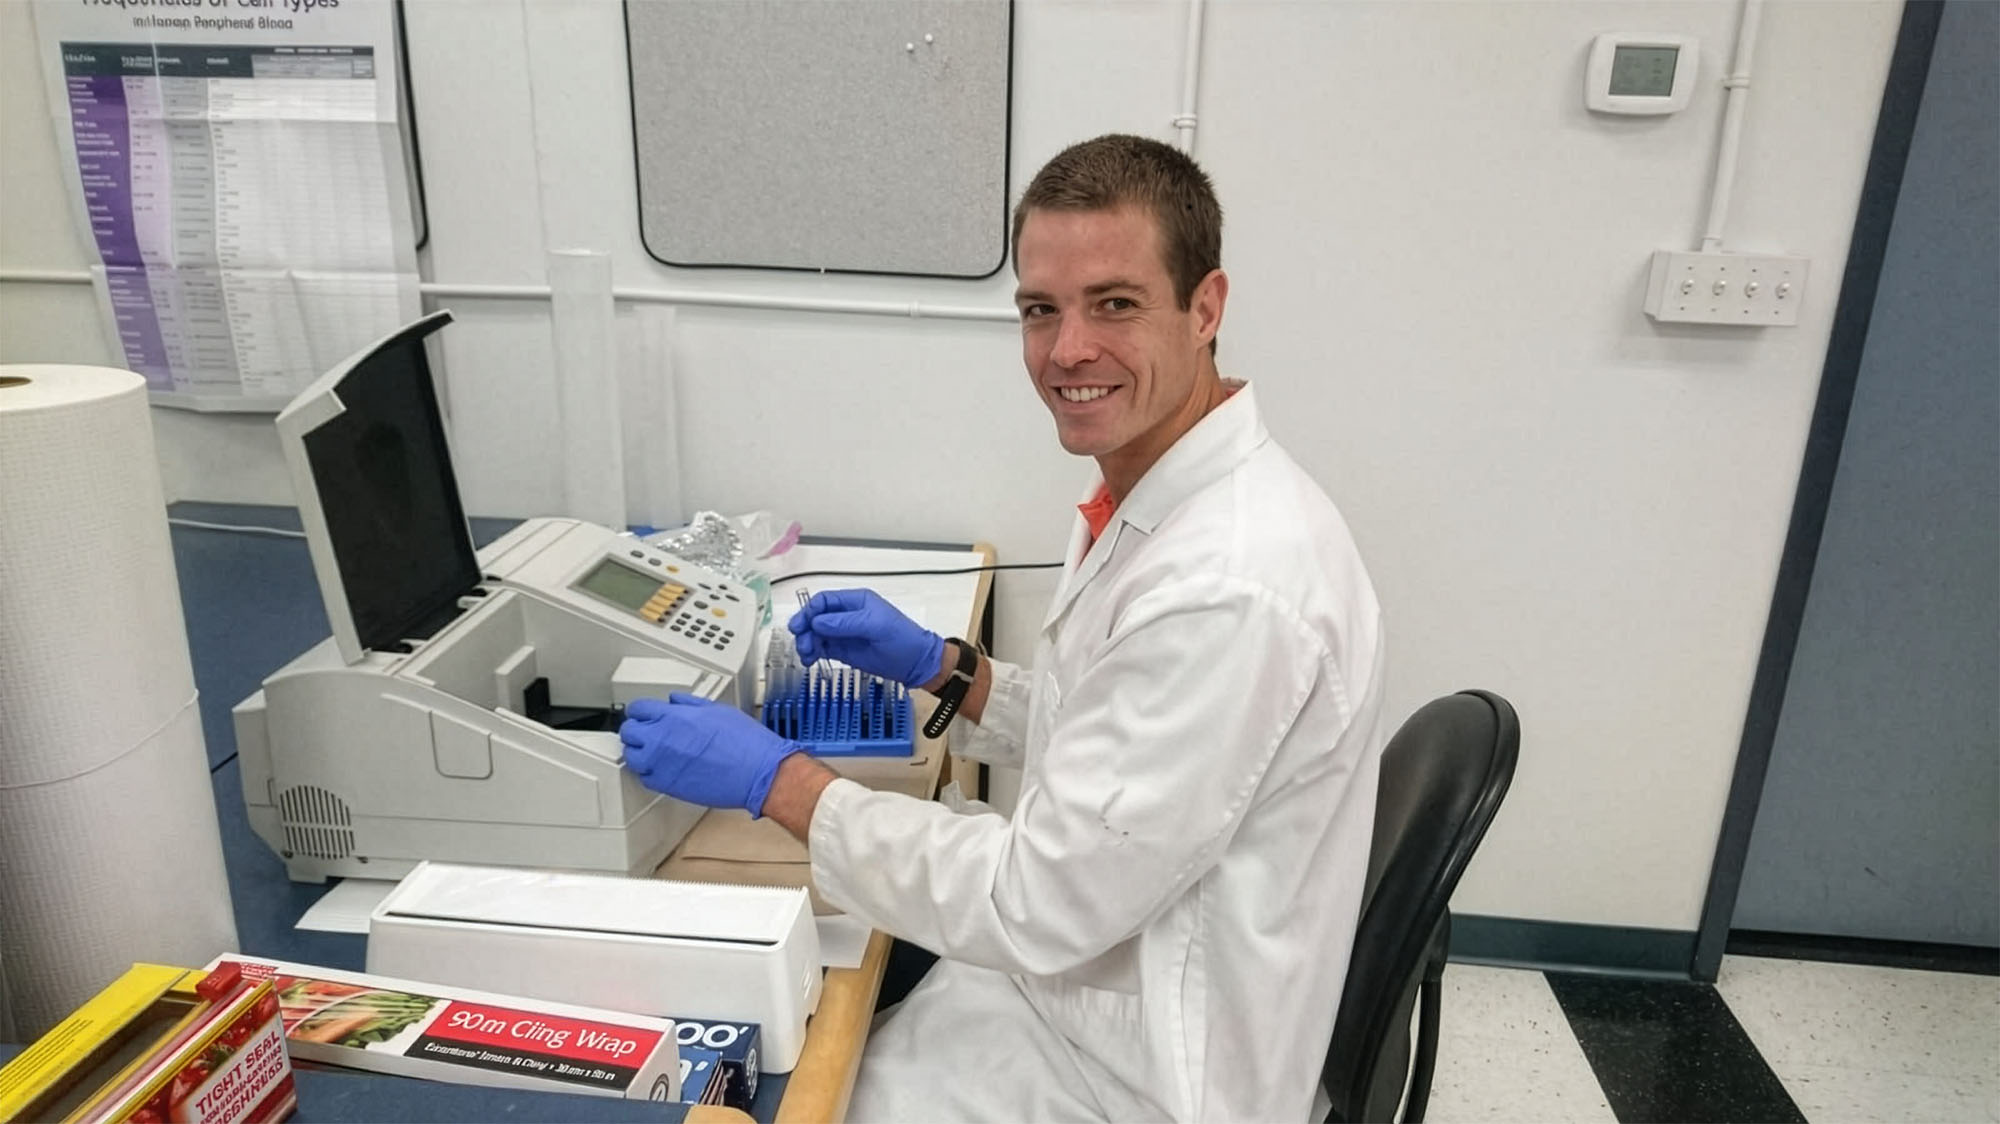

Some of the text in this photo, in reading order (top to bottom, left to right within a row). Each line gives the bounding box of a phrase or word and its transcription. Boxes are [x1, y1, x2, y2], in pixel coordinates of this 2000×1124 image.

[447, 1010, 507, 1034] 90m
[576, 1029, 637, 1058] Wrap
[195, 1063, 242, 1115] TIGHT
[244, 1031, 280, 1070] SEAL
